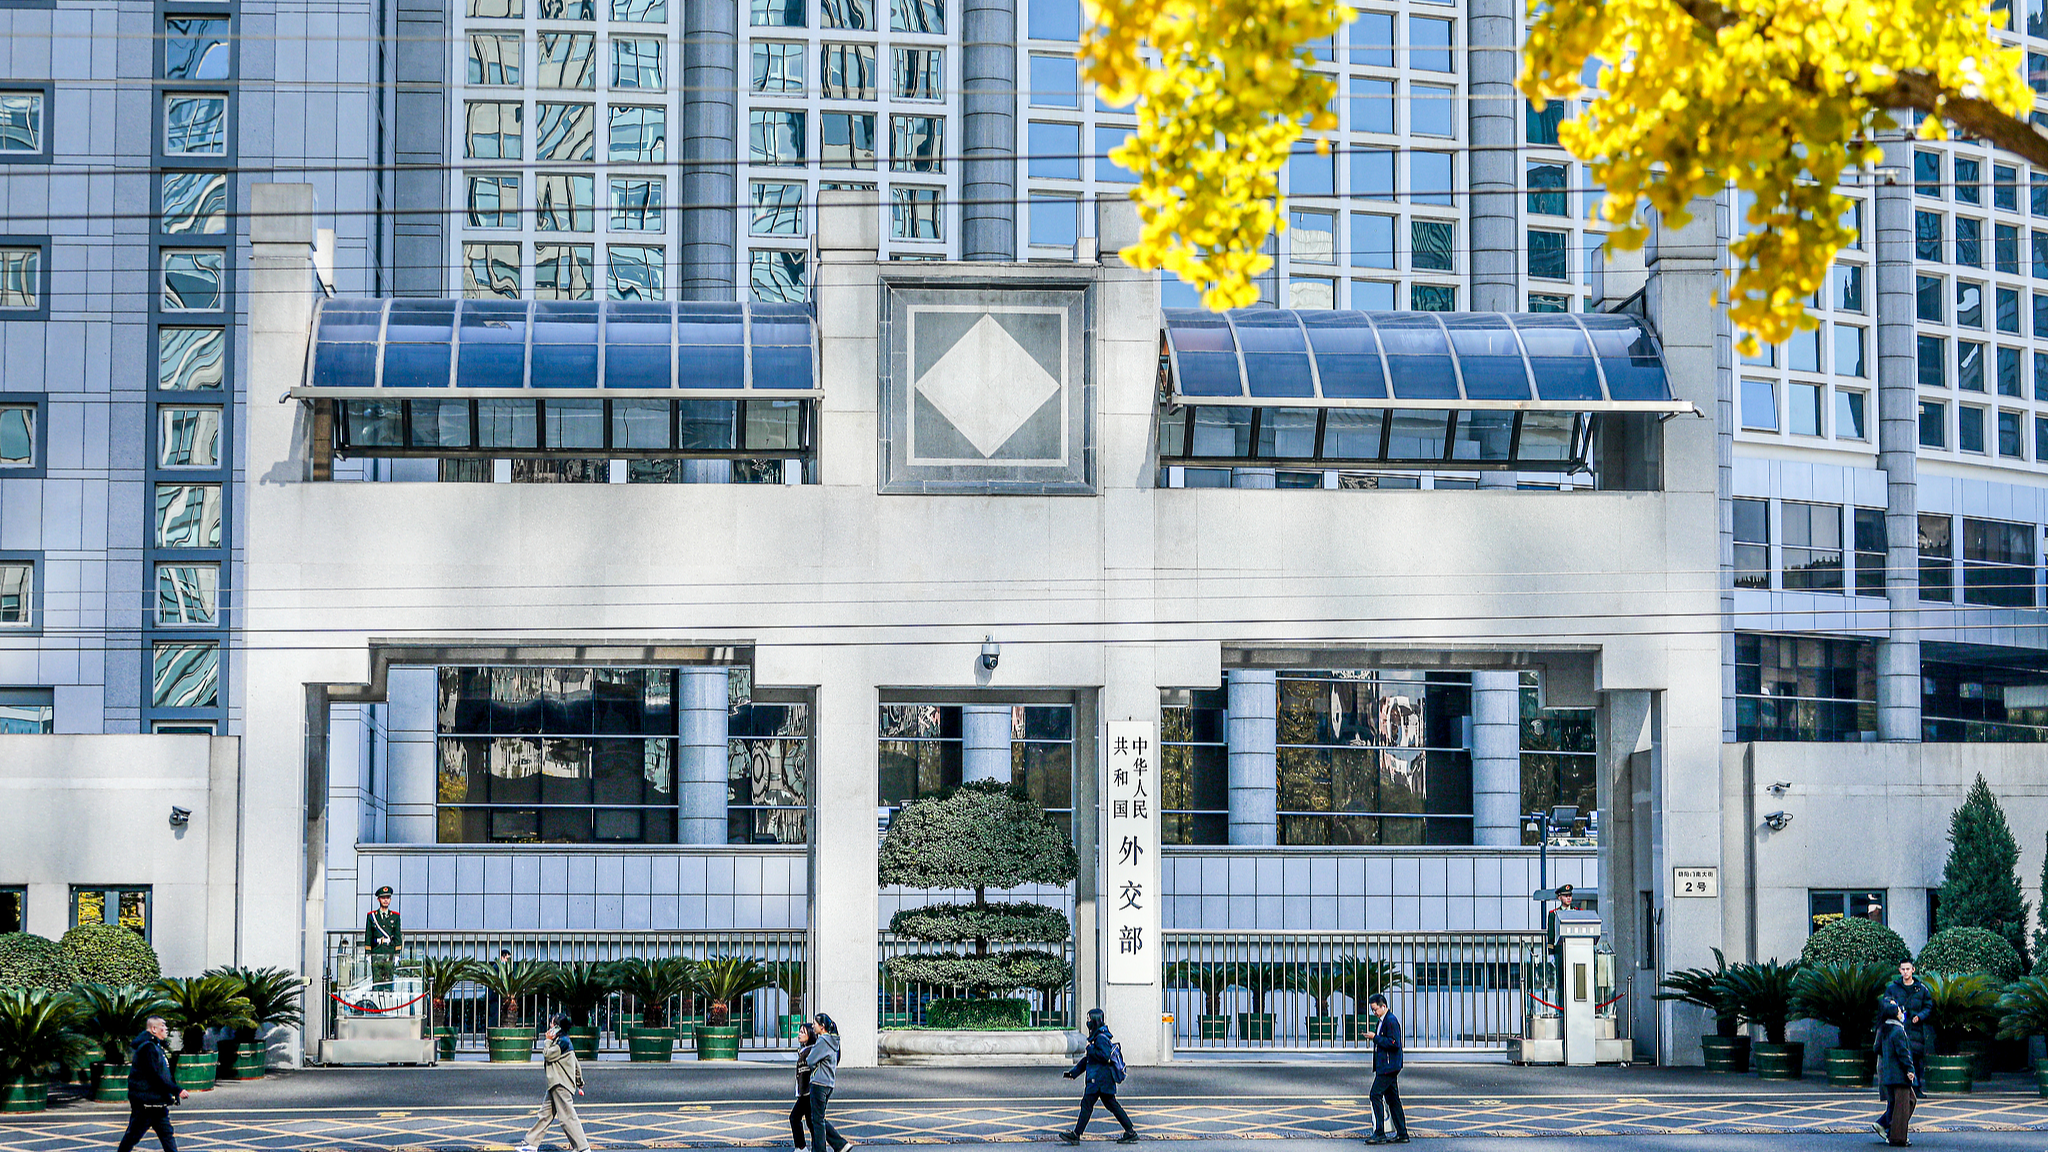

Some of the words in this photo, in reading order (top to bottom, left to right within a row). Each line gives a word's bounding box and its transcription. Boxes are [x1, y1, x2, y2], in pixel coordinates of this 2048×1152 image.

[1113, 736, 1128, 819] 共和国
[1132, 736, 1148, 819] 中华人民
[1118, 835, 1144, 955] 外交部
